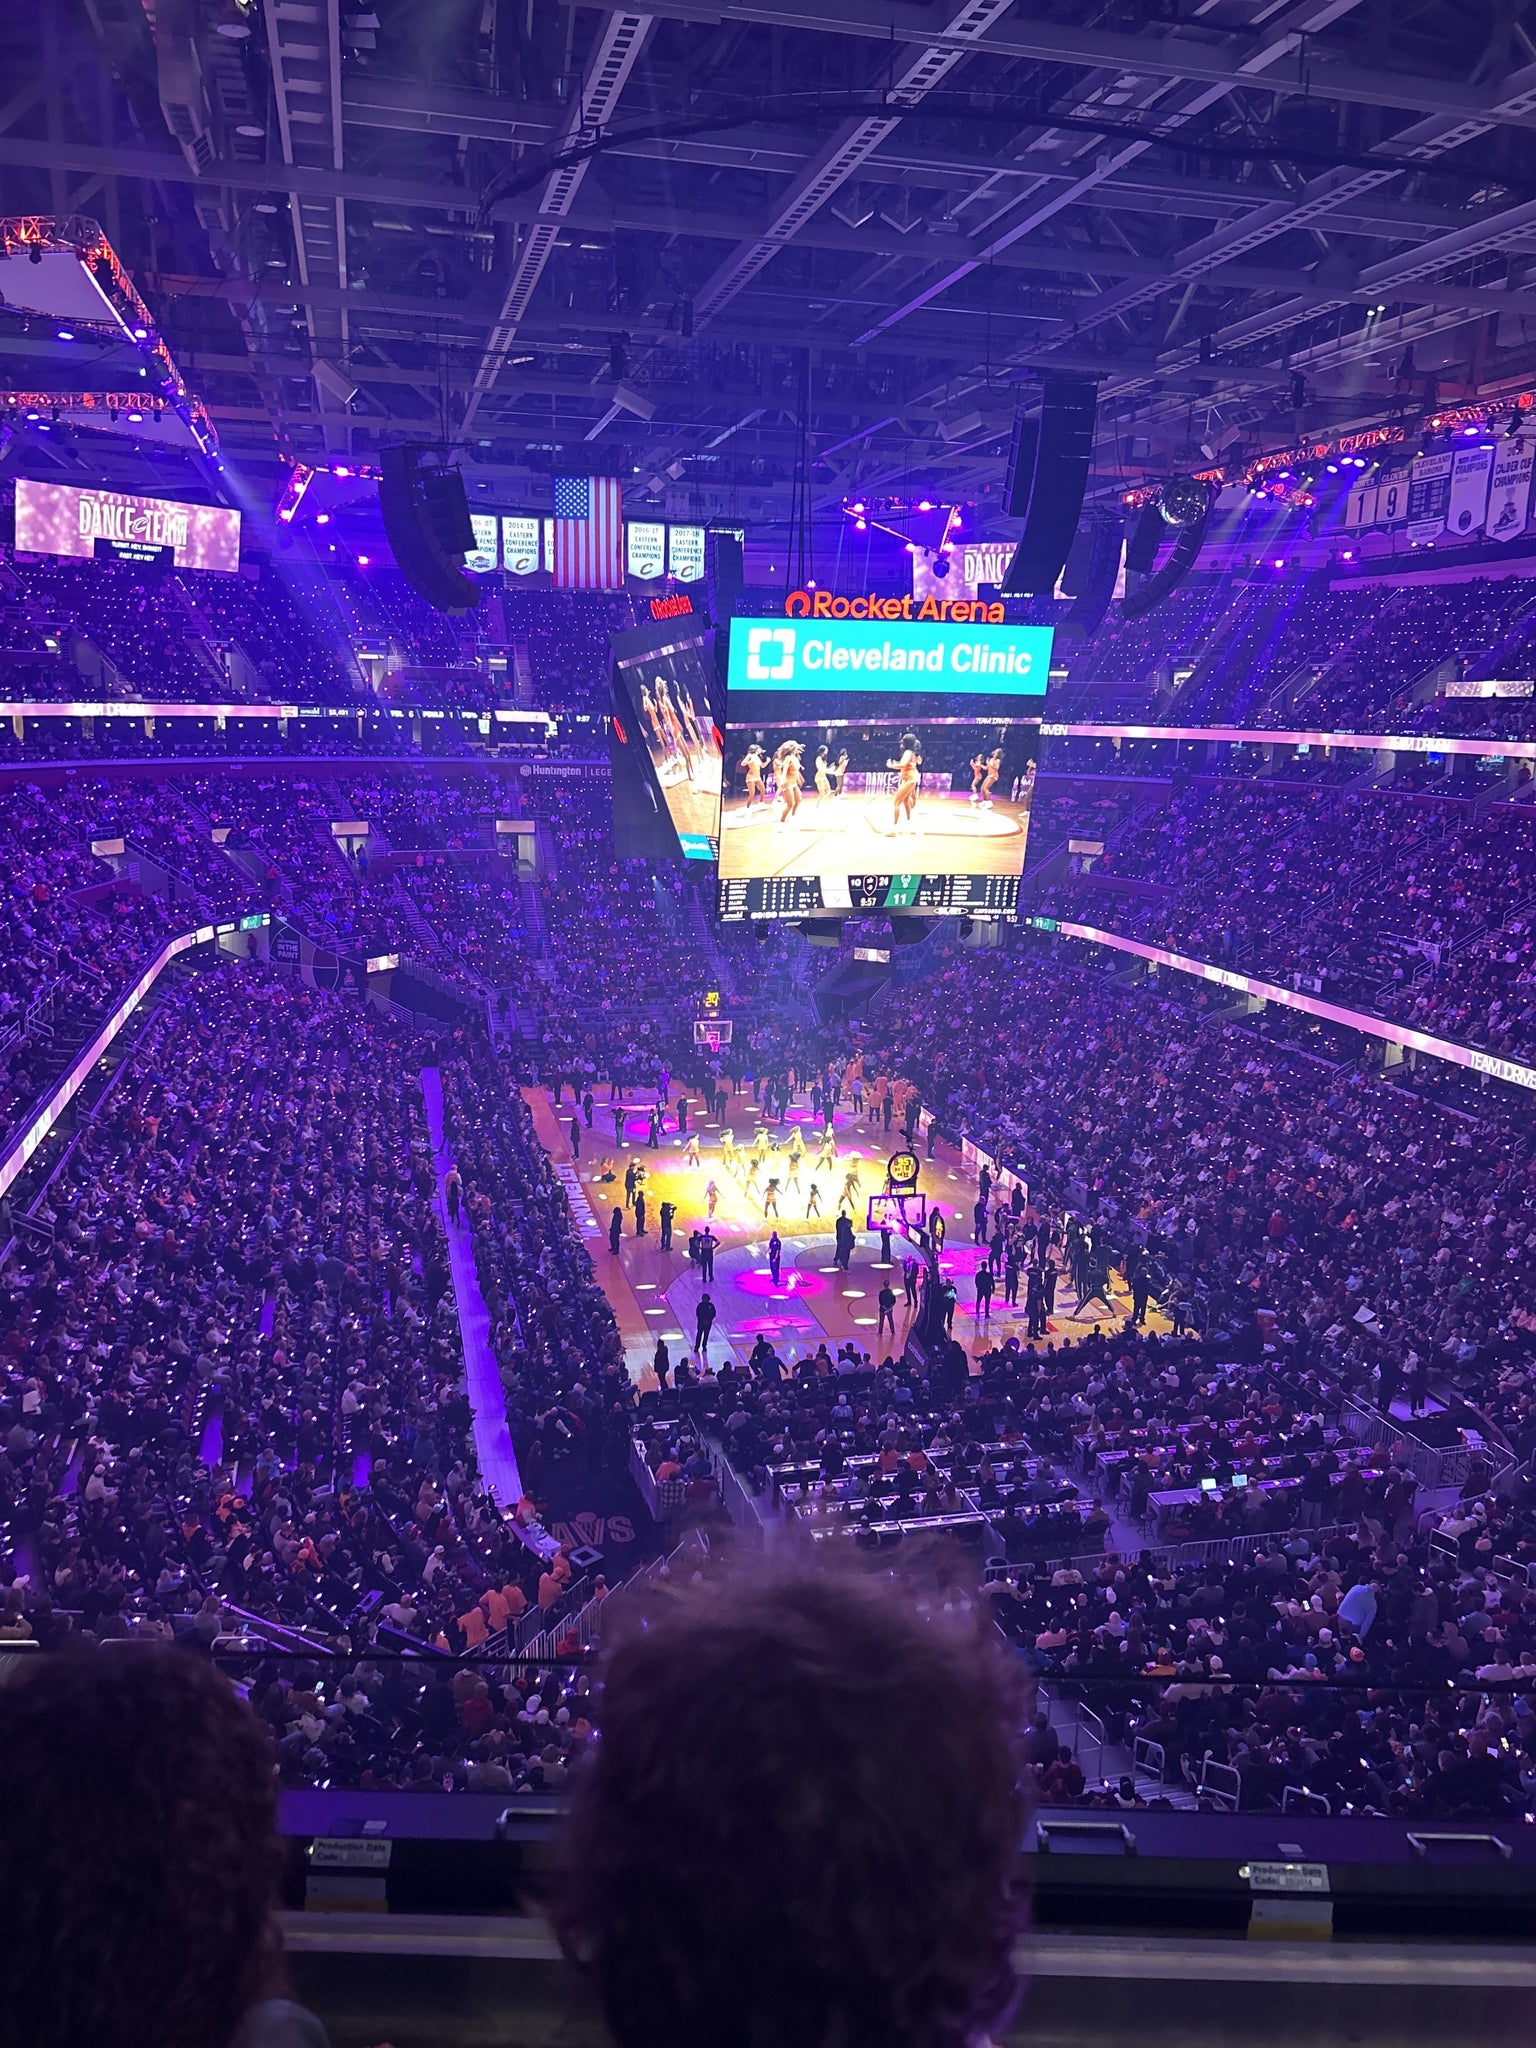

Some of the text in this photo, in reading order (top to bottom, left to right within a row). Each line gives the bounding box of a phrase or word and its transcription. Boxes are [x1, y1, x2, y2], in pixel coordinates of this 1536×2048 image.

[1414, 455, 1450, 469] CLEVELAND
[1496, 461, 1518, 475] CALDER
[1494, 472, 1531, 488] CHAMPIONS
[1358, 493, 1364, 523] 1
[1387, 487, 1397, 517] 9
[79, 500, 136, 540] DANCE
[143, 509, 188, 546] TEAM
[505, 539, 538, 547] CONFERENCE
[671, 546, 703, 554] CONFERENCE
[506, 547, 537, 555] CHAMPIONS
[813, 591, 1005, 623] Rocket Arena
[802, 639, 1032, 675] Cleveland Clinic
[482, 712, 491, 720] 25
[1039, 724, 1068, 736] RIVEN
[532, 765, 582, 777] Huntington
[879, 877, 889, 886] 24
[860, 897, 877, 906] 9:57
[894, 893, 907, 905] 11
[277, 951, 299, 959] PAINT
[1471, 1051, 1536, 1089] TEAM DRIVE
[554, 1163, 579, 1182] LET
[908, 1342, 925, 1366] coinbase
[551, 1512, 636, 1550] AVS
[318, 1841, 386, 1852] Production Date
